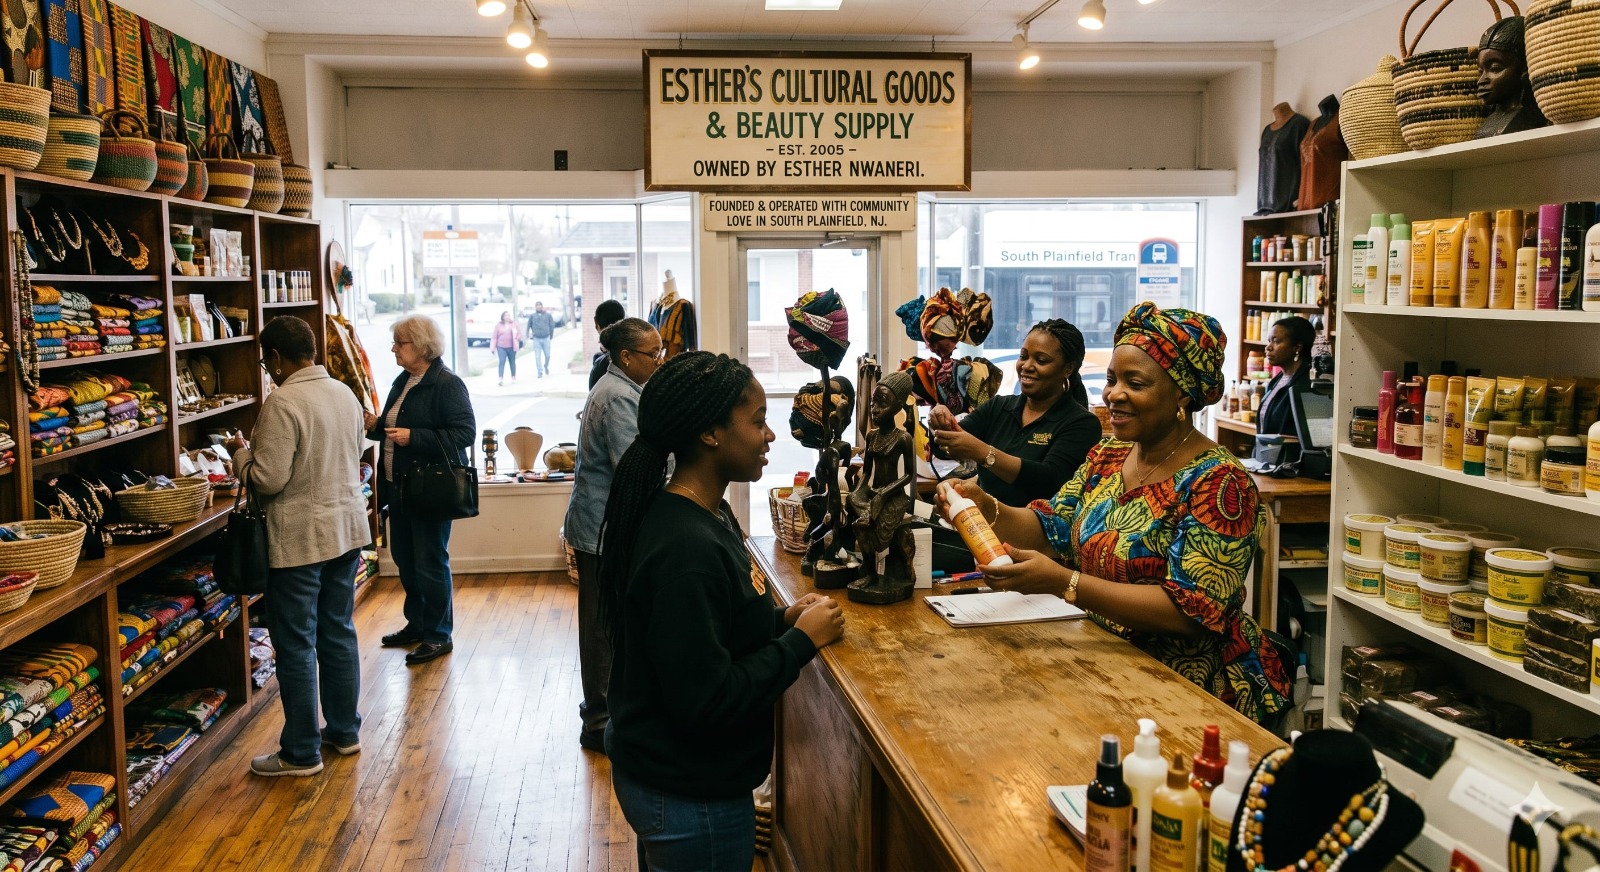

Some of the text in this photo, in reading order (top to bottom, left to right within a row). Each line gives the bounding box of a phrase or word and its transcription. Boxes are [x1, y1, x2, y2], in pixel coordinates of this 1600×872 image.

[660, 65, 956, 105] ESTHER'S CULTURAL GOODS
[706, 111, 914, 139] & BEAUTY SUPPLY
[778, 144, 806, 156] EST.
[810, 144, 845, 156] 2005
[693, 160, 925, 178] OWNED BY ESTHER NWANERI.
[709, 200, 910, 212] FOUNDED & OPERATED WITH COMMUNITY
[726, 215, 887, 228] LOVE IN SOUTH PLAINFIELD, NJ.
[1001, 250, 1039, 262] South
[1044, 250, 1103, 262] Plainfield
